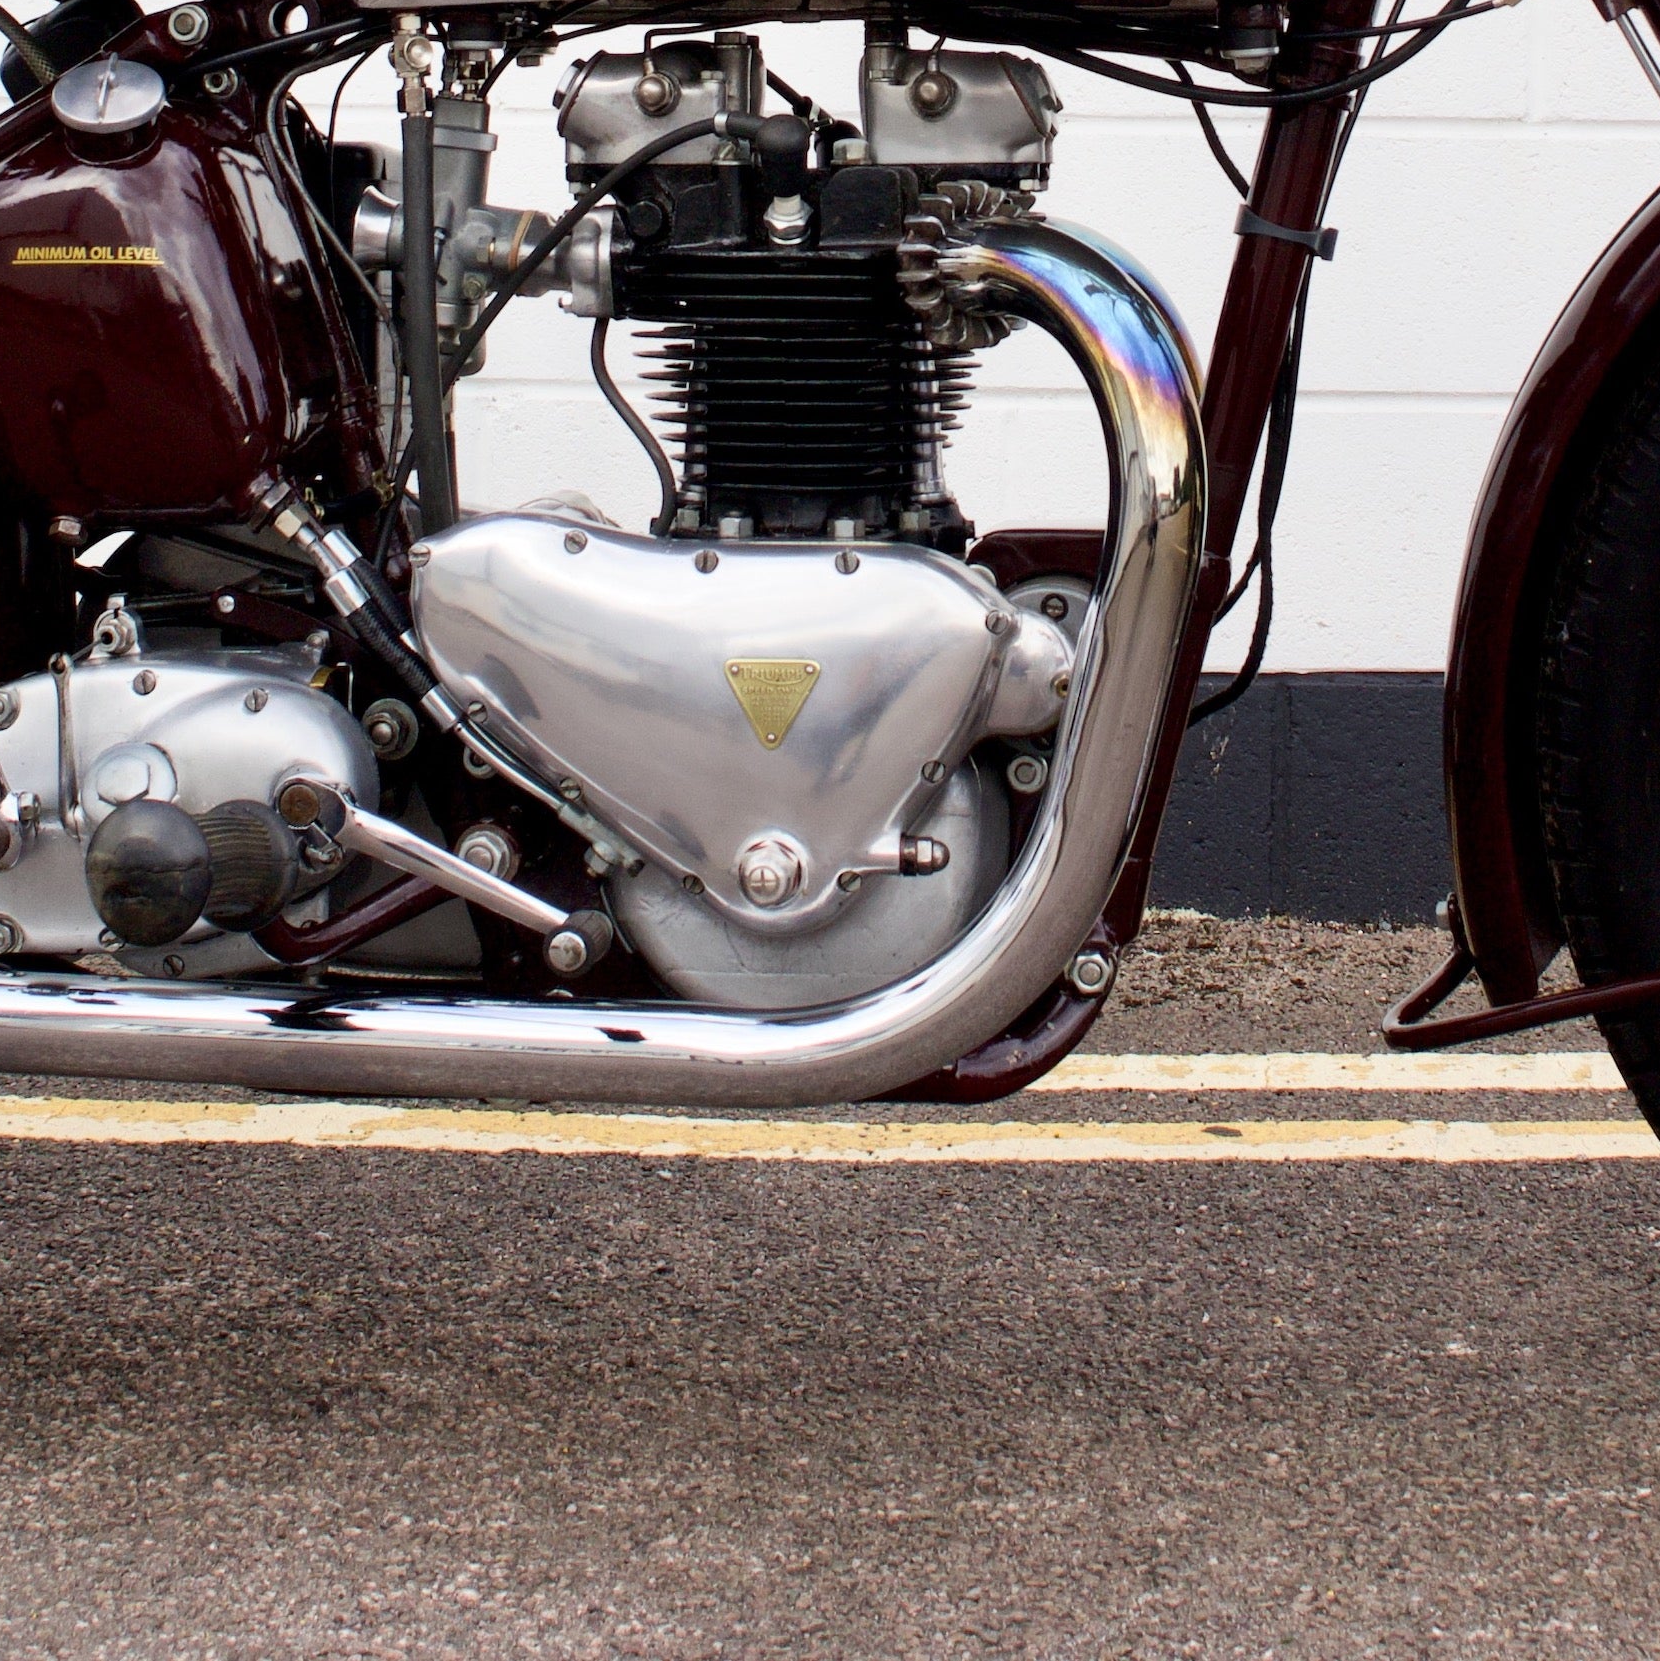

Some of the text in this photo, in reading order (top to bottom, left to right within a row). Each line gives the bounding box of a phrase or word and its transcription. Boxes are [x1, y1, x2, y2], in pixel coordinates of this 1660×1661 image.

[17, 246, 159, 260] MINIMUM OIL LEVEL
[740, 665, 804, 680] TRIUMPH
